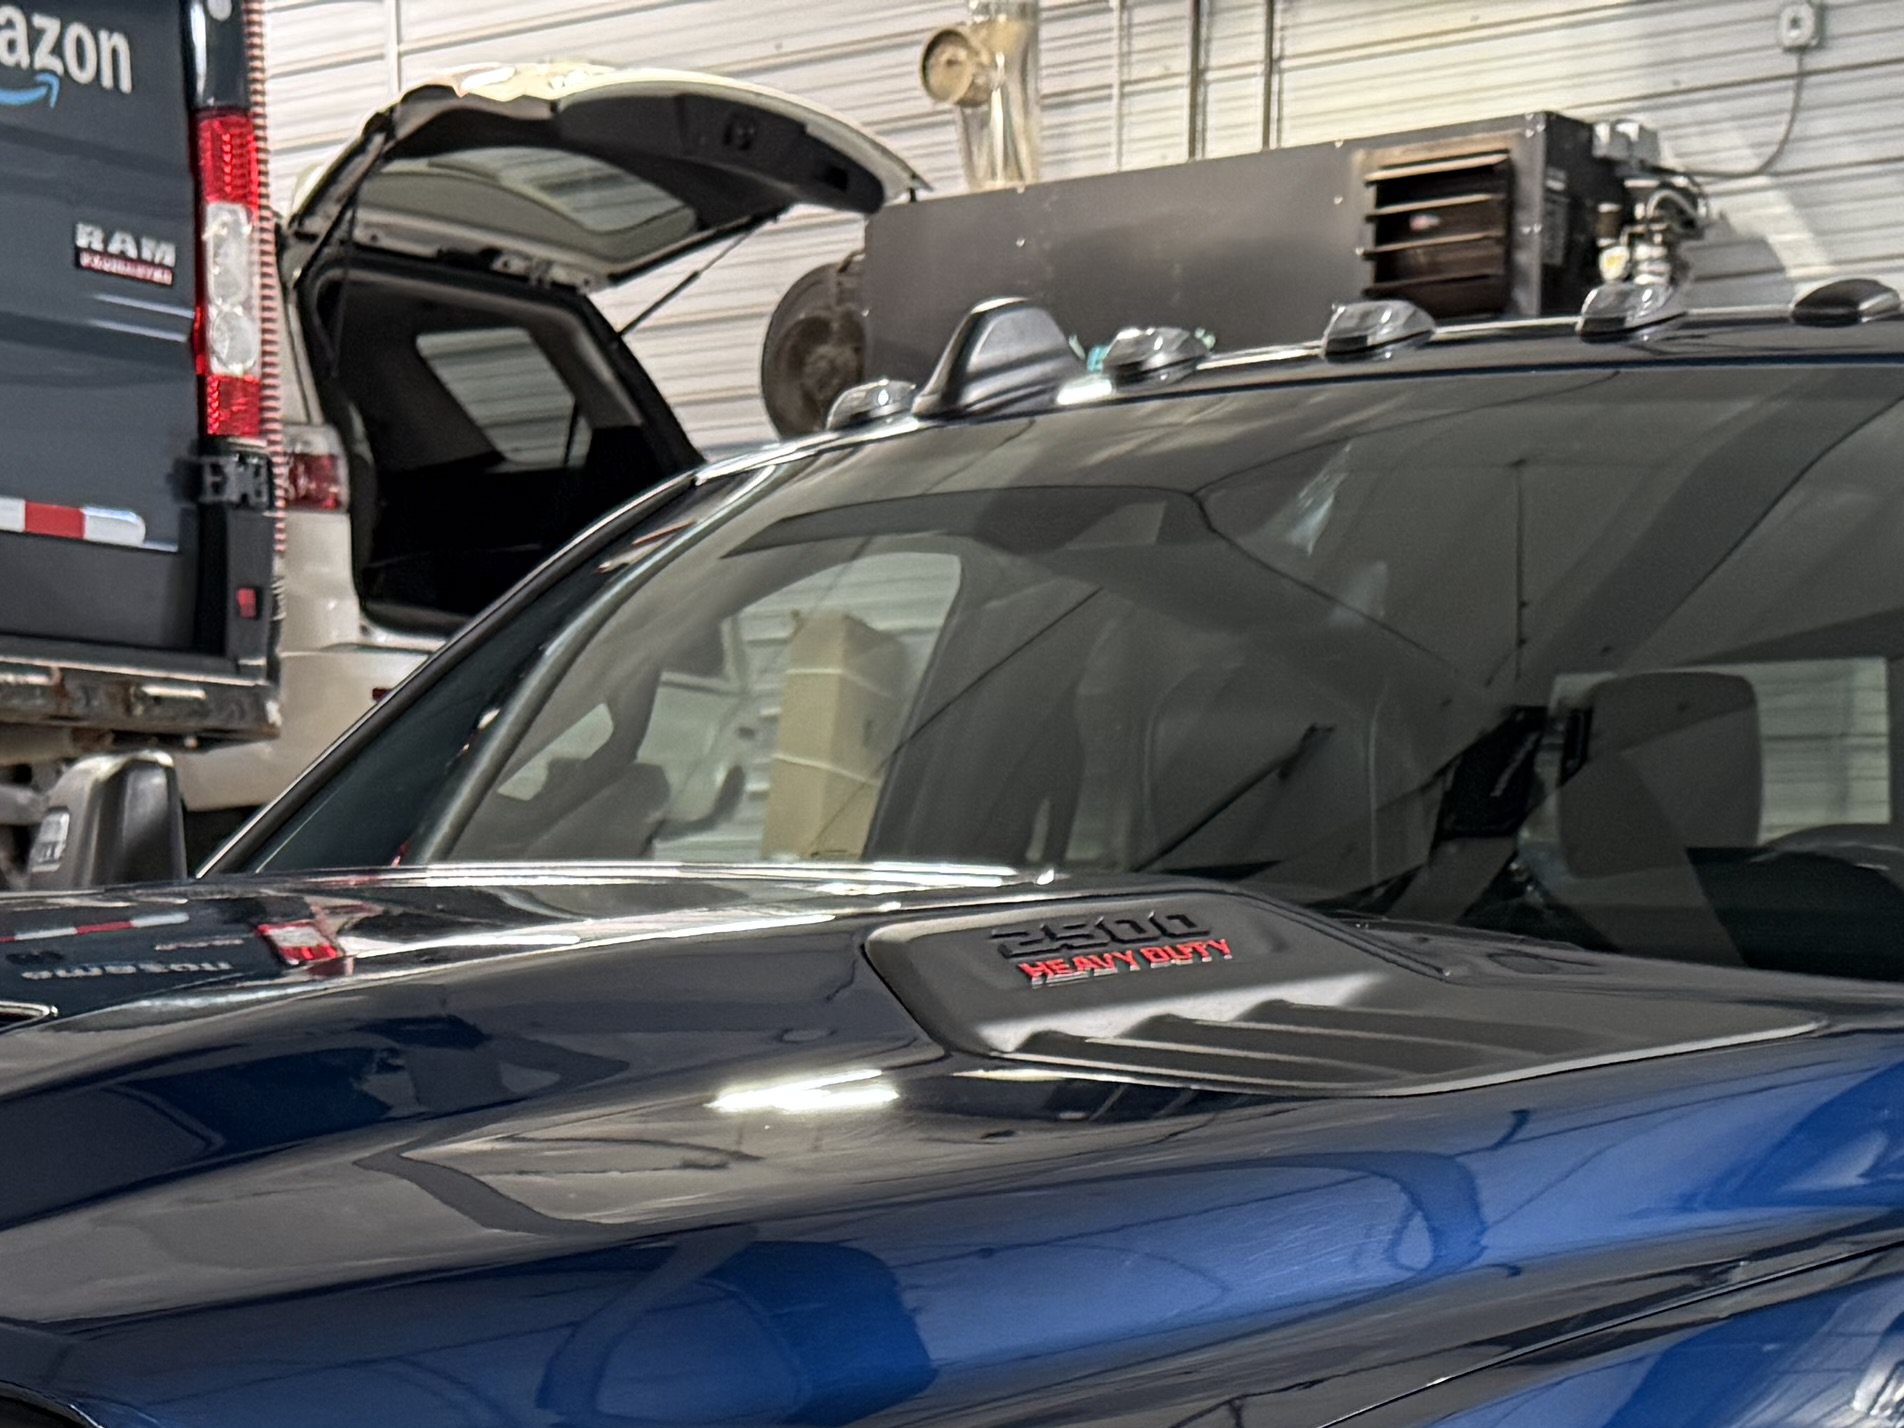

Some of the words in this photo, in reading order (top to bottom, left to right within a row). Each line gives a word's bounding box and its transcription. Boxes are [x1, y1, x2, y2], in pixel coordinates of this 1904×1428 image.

[75, 222, 176, 268] RAM
[988, 909, 1212, 960] 2500
[1018, 949, 1141, 988] HEAVY
[1139, 938, 1233, 969] DUTY
